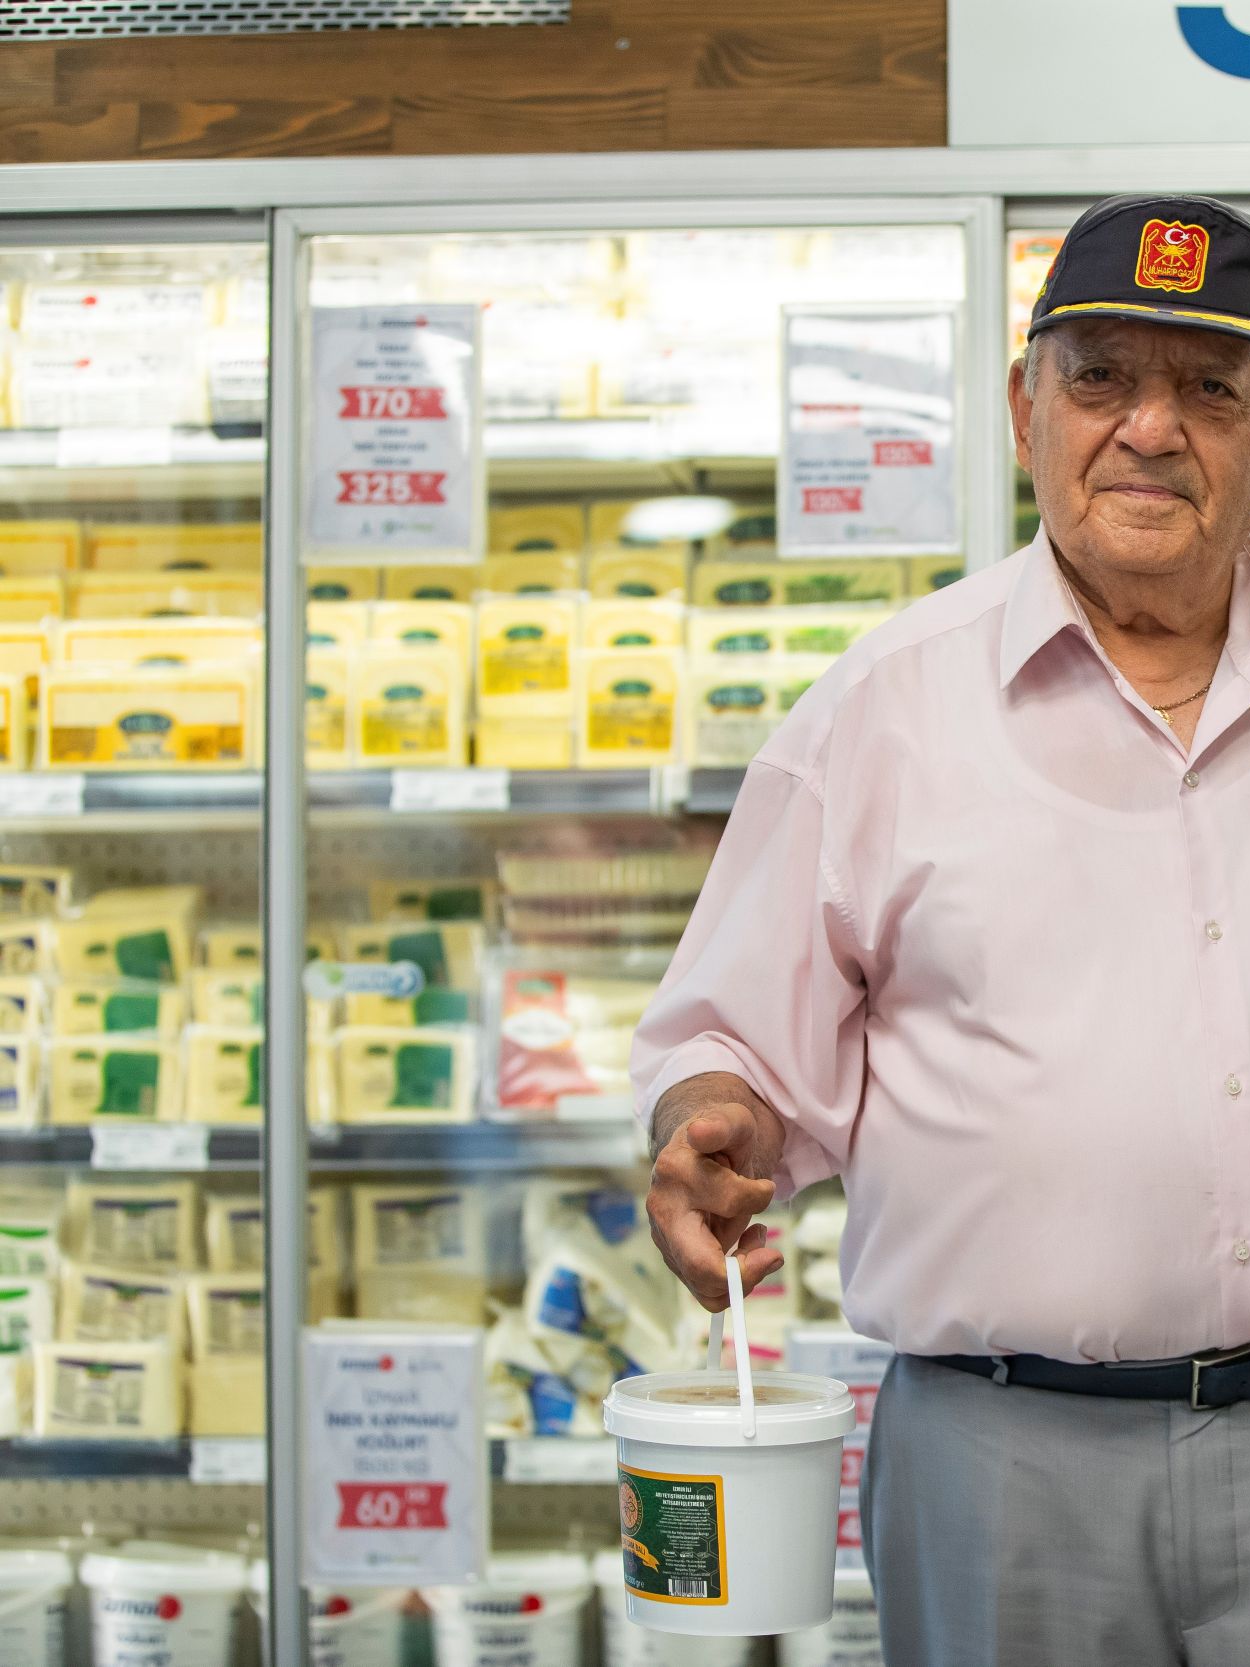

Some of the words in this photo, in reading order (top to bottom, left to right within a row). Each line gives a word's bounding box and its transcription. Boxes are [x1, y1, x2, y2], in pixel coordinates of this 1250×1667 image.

[358, 390, 412, 417] 170
[350, 475, 411, 502] 325
[356, 1490, 400, 1525] 60
